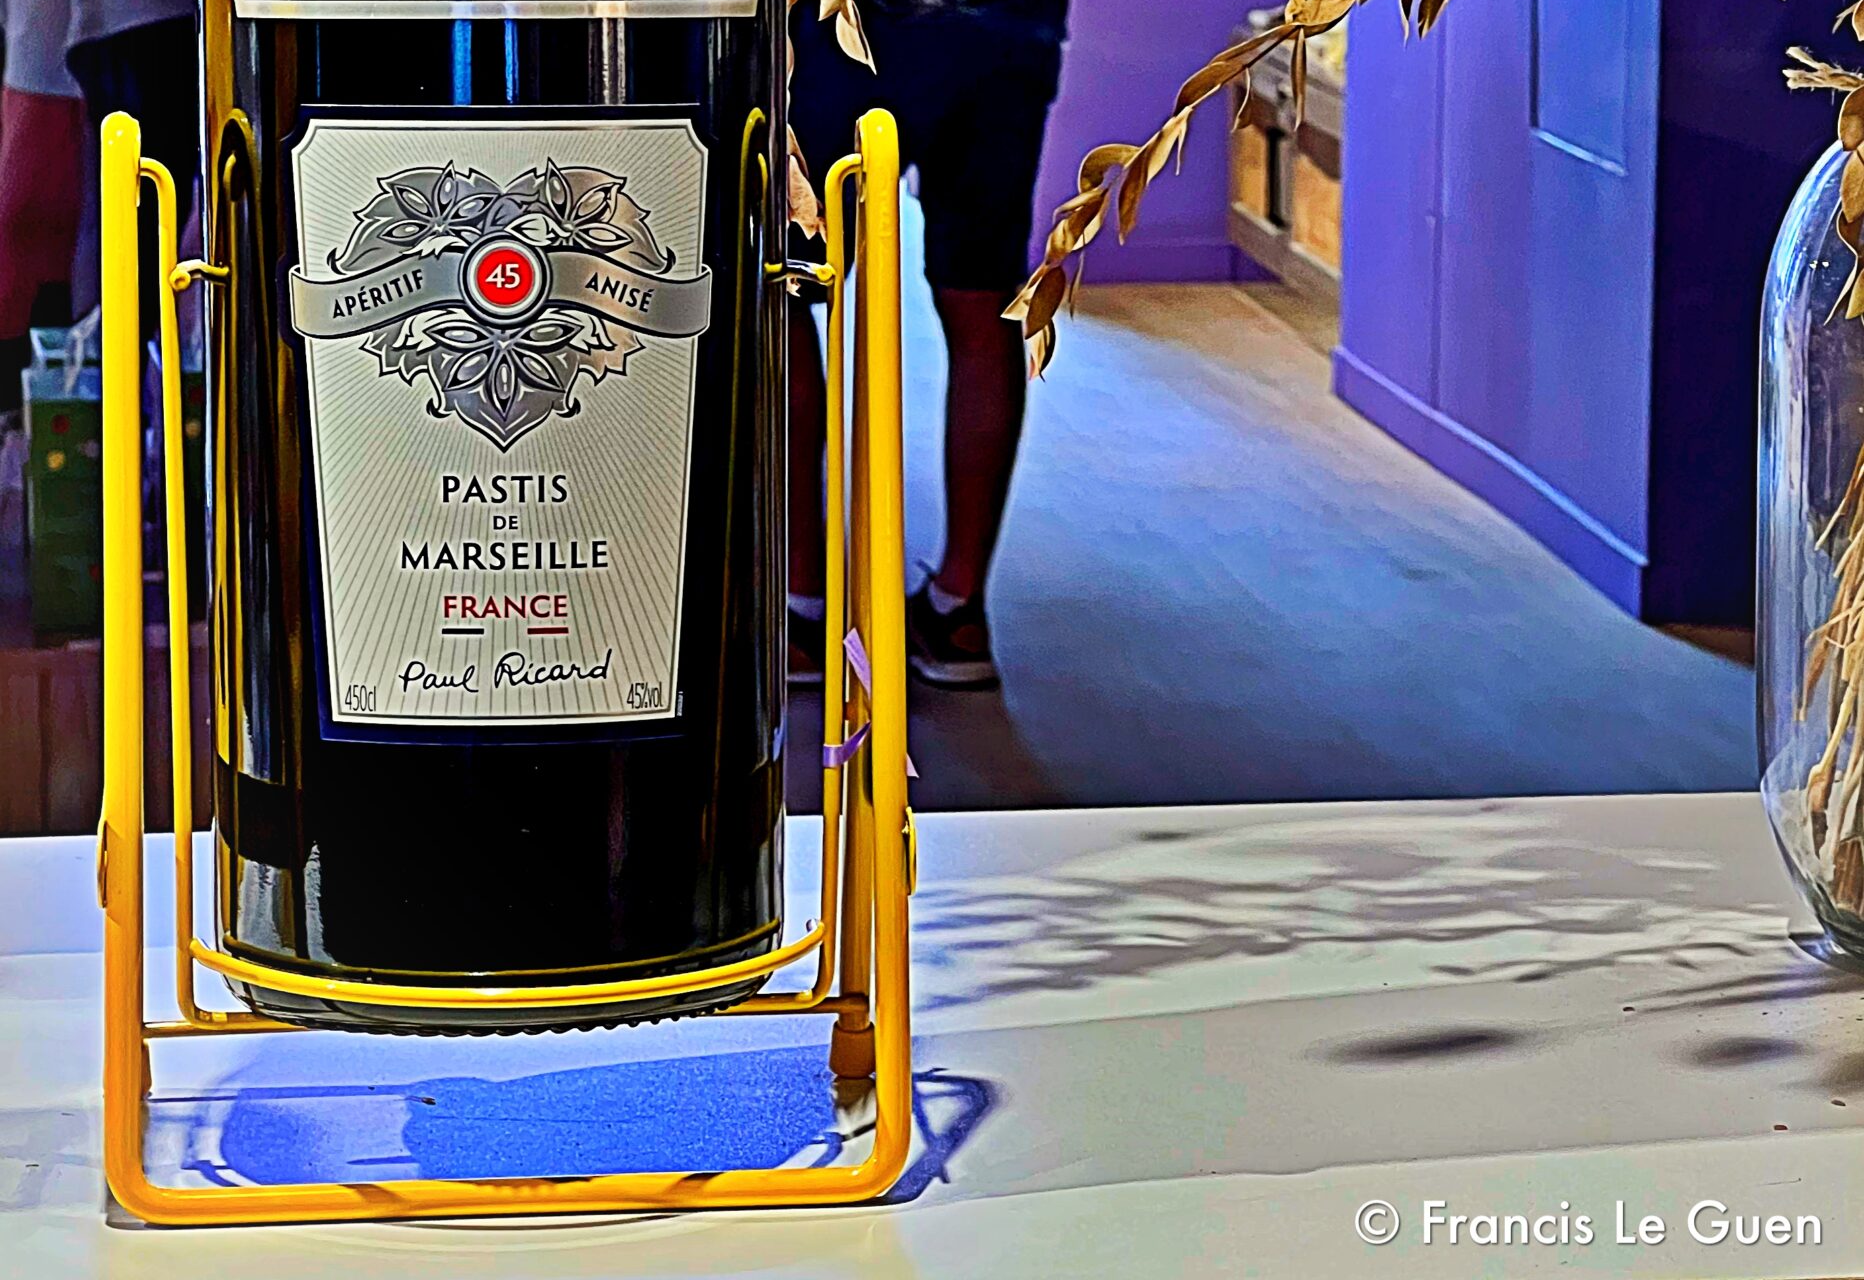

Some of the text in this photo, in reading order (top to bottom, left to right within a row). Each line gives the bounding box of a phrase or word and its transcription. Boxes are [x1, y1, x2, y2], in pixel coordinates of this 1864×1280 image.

[485, 263, 520, 289] 45
[333, 269, 424, 319] APÉRITIF
[585, 271, 653, 313] ANISÉ
[442, 475, 568, 504] PASTIS
[492, 515, 519, 531] DE
[401, 541, 608, 570] MARSEILLE
[443, 595, 568, 619] FRANCE
[398, 648, 613, 693] Paul Ricard
[345, 684, 377, 712] 450cl
